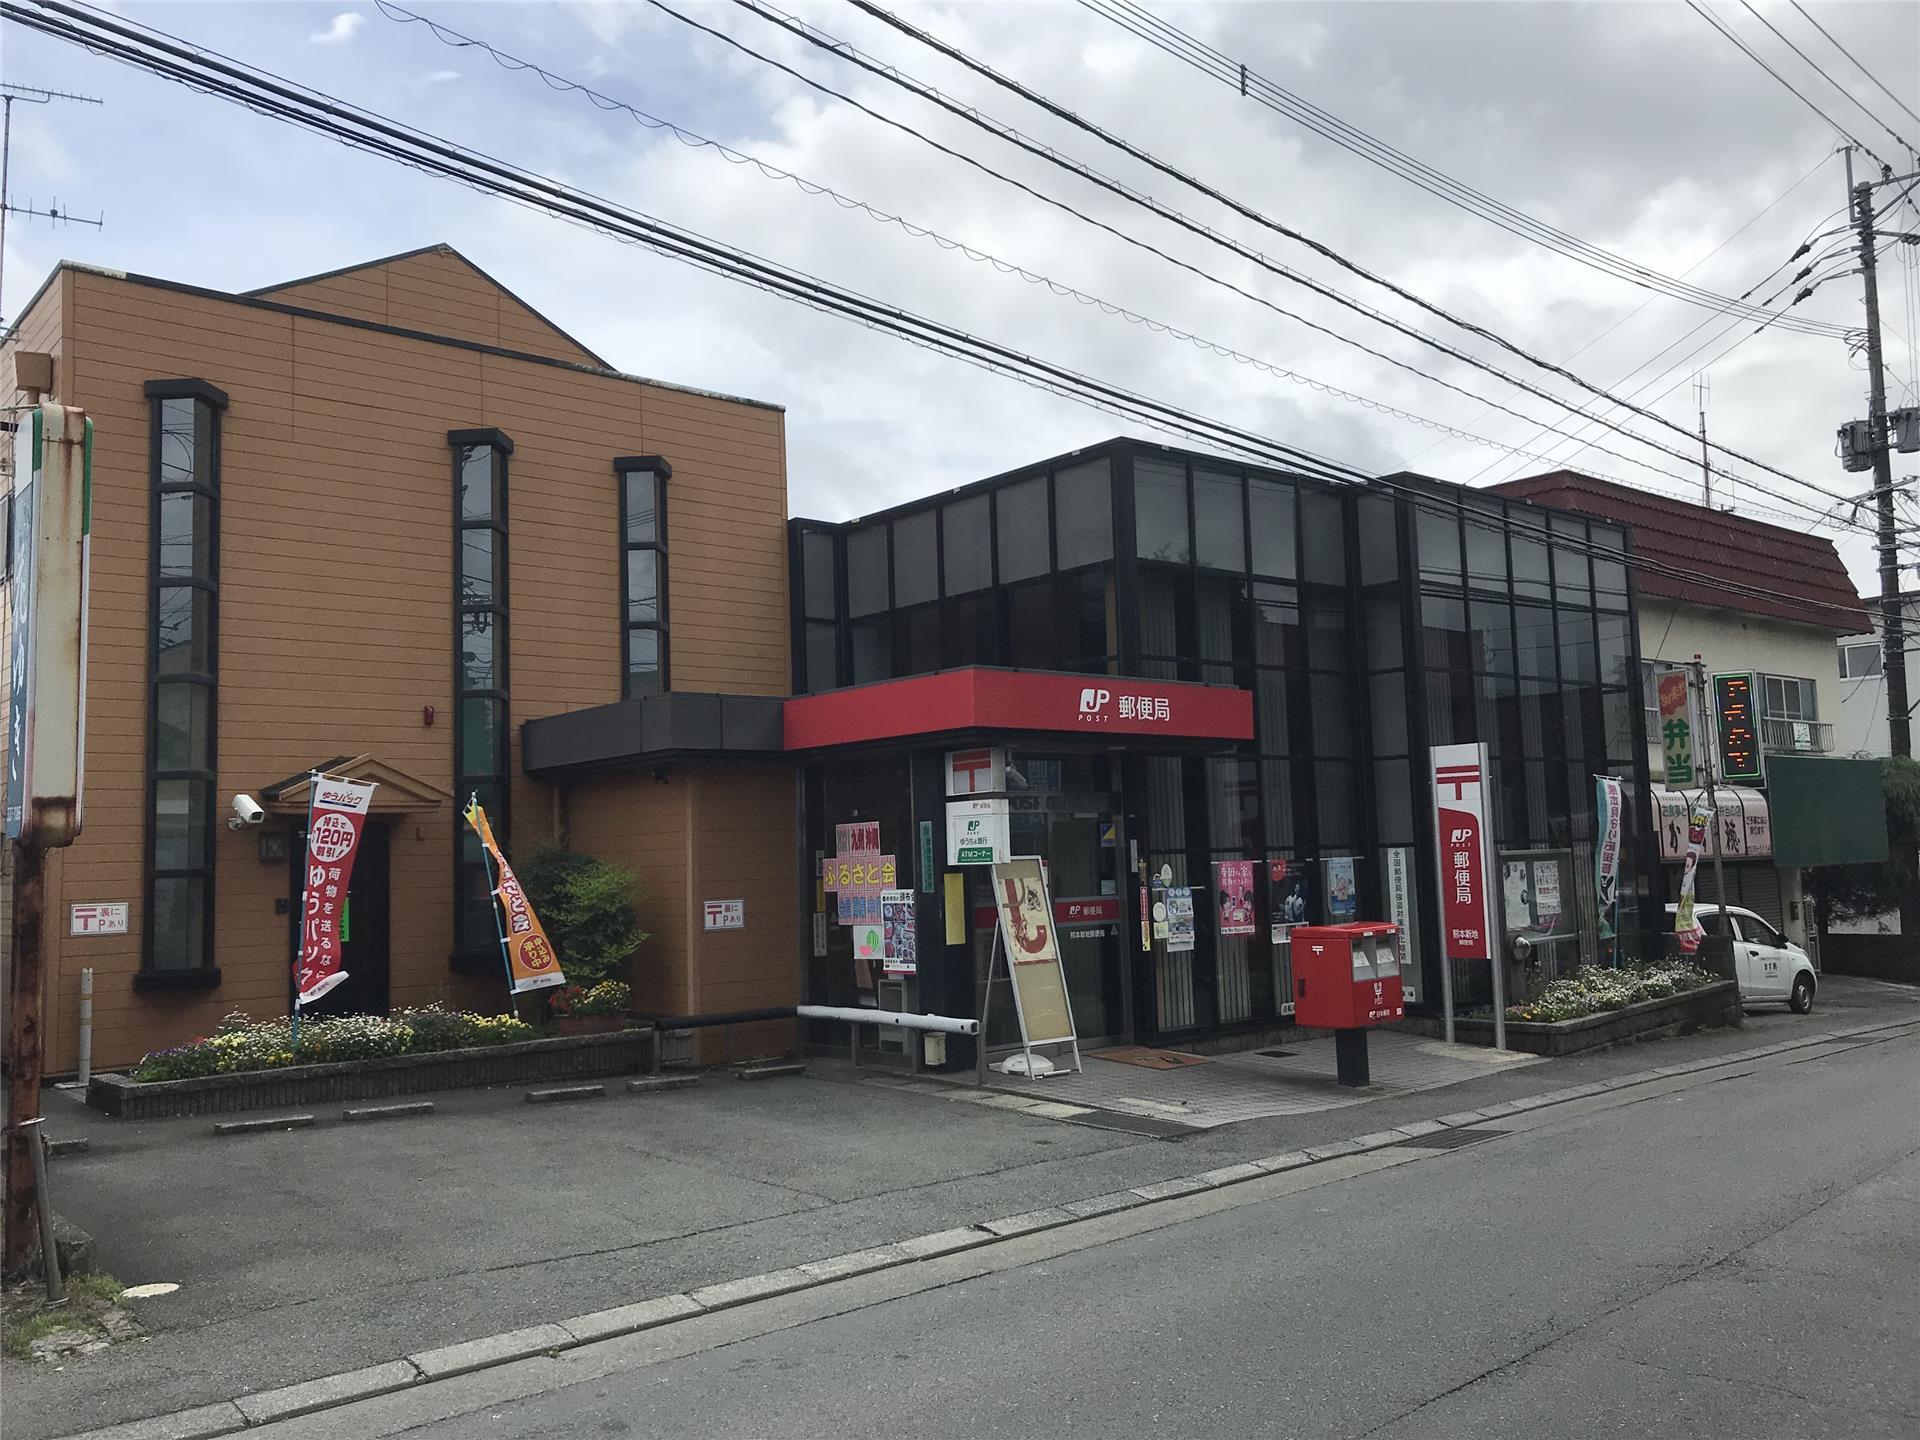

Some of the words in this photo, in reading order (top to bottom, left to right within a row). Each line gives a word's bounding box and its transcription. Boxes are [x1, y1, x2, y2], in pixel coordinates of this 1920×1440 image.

[1078, 714, 1109, 722] POST
[1119, 695, 1170, 722] 郵便局
[1662, 718, 1692, 783] 弁当
[322, 791, 363, 805] ゆうパック
[323, 817, 347, 829] 持込で
[316, 827, 353, 847] 120円
[960, 837, 989, 845] ゆうちょ銀行
[961, 850, 991, 859] ATMコーナー
[825, 862, 896, 885] ふるさと会
[1454, 851, 1472, 904] 郵便局
[300, 865, 326, 985] ゆうパック
[315, 866, 342, 979] 荷物を送るなら
[1452, 929, 1478, 939] 熊本新地
